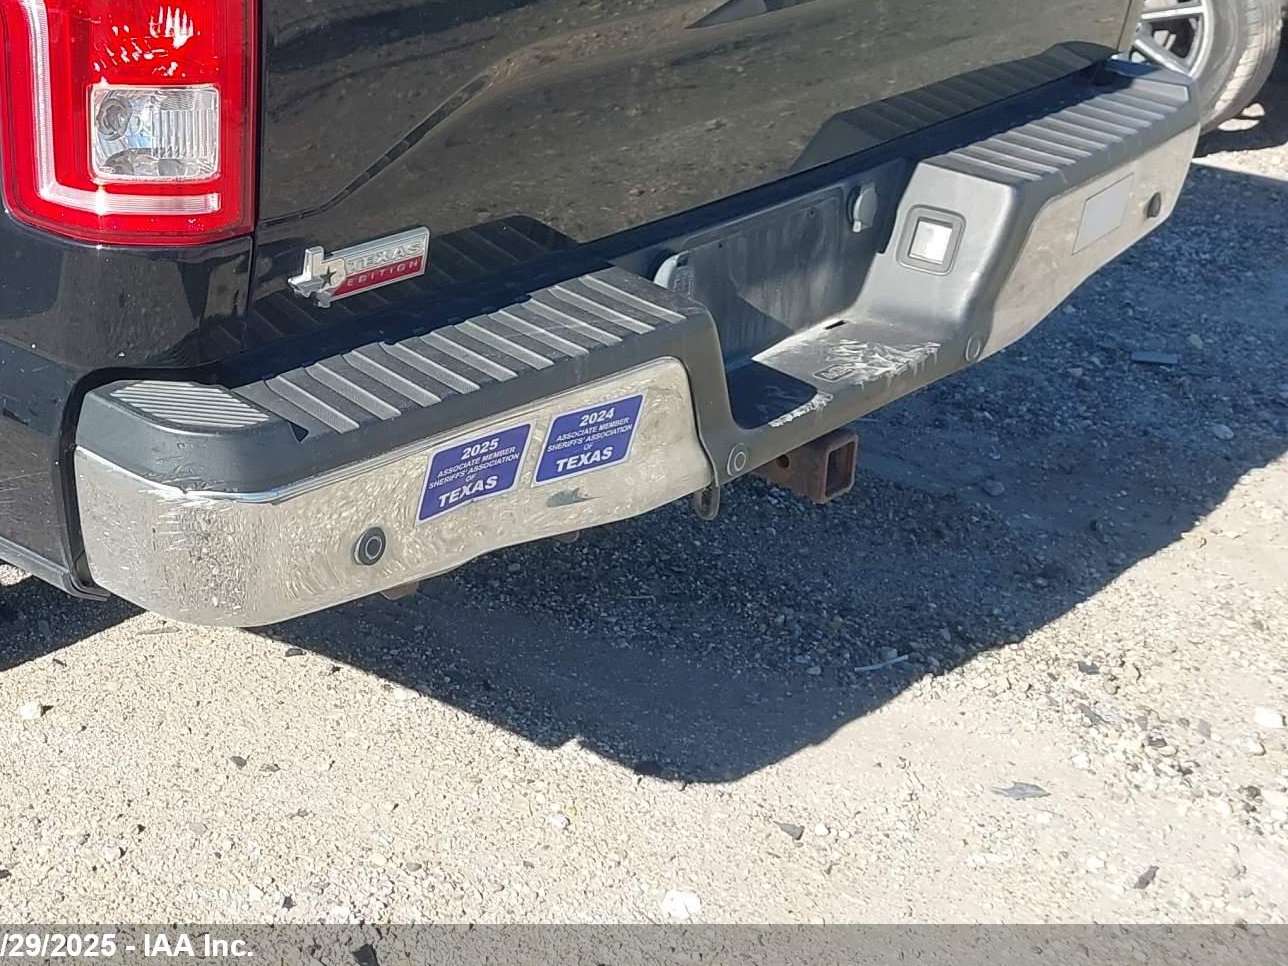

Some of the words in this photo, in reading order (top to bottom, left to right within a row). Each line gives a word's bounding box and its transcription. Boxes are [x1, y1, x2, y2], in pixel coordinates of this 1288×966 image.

[345, 241, 422, 269] TEXAS
[347, 260, 418, 286] EDITION
[556, 425, 599, 442] ASSOCIATE
[598, 417, 630, 433] MEMBER
[579, 407, 615, 427] 2024
[585, 424, 633, 442] ASSOCIATION
[461, 438, 500, 460] 2025
[555, 446, 614, 472] TEXAS
[437, 457, 482, 478] ASSOCIATE
[481, 446, 516, 462] MEMBER
[467, 453, 520, 474] ASSOCIATION
[438, 475, 498, 508] TEXAS
